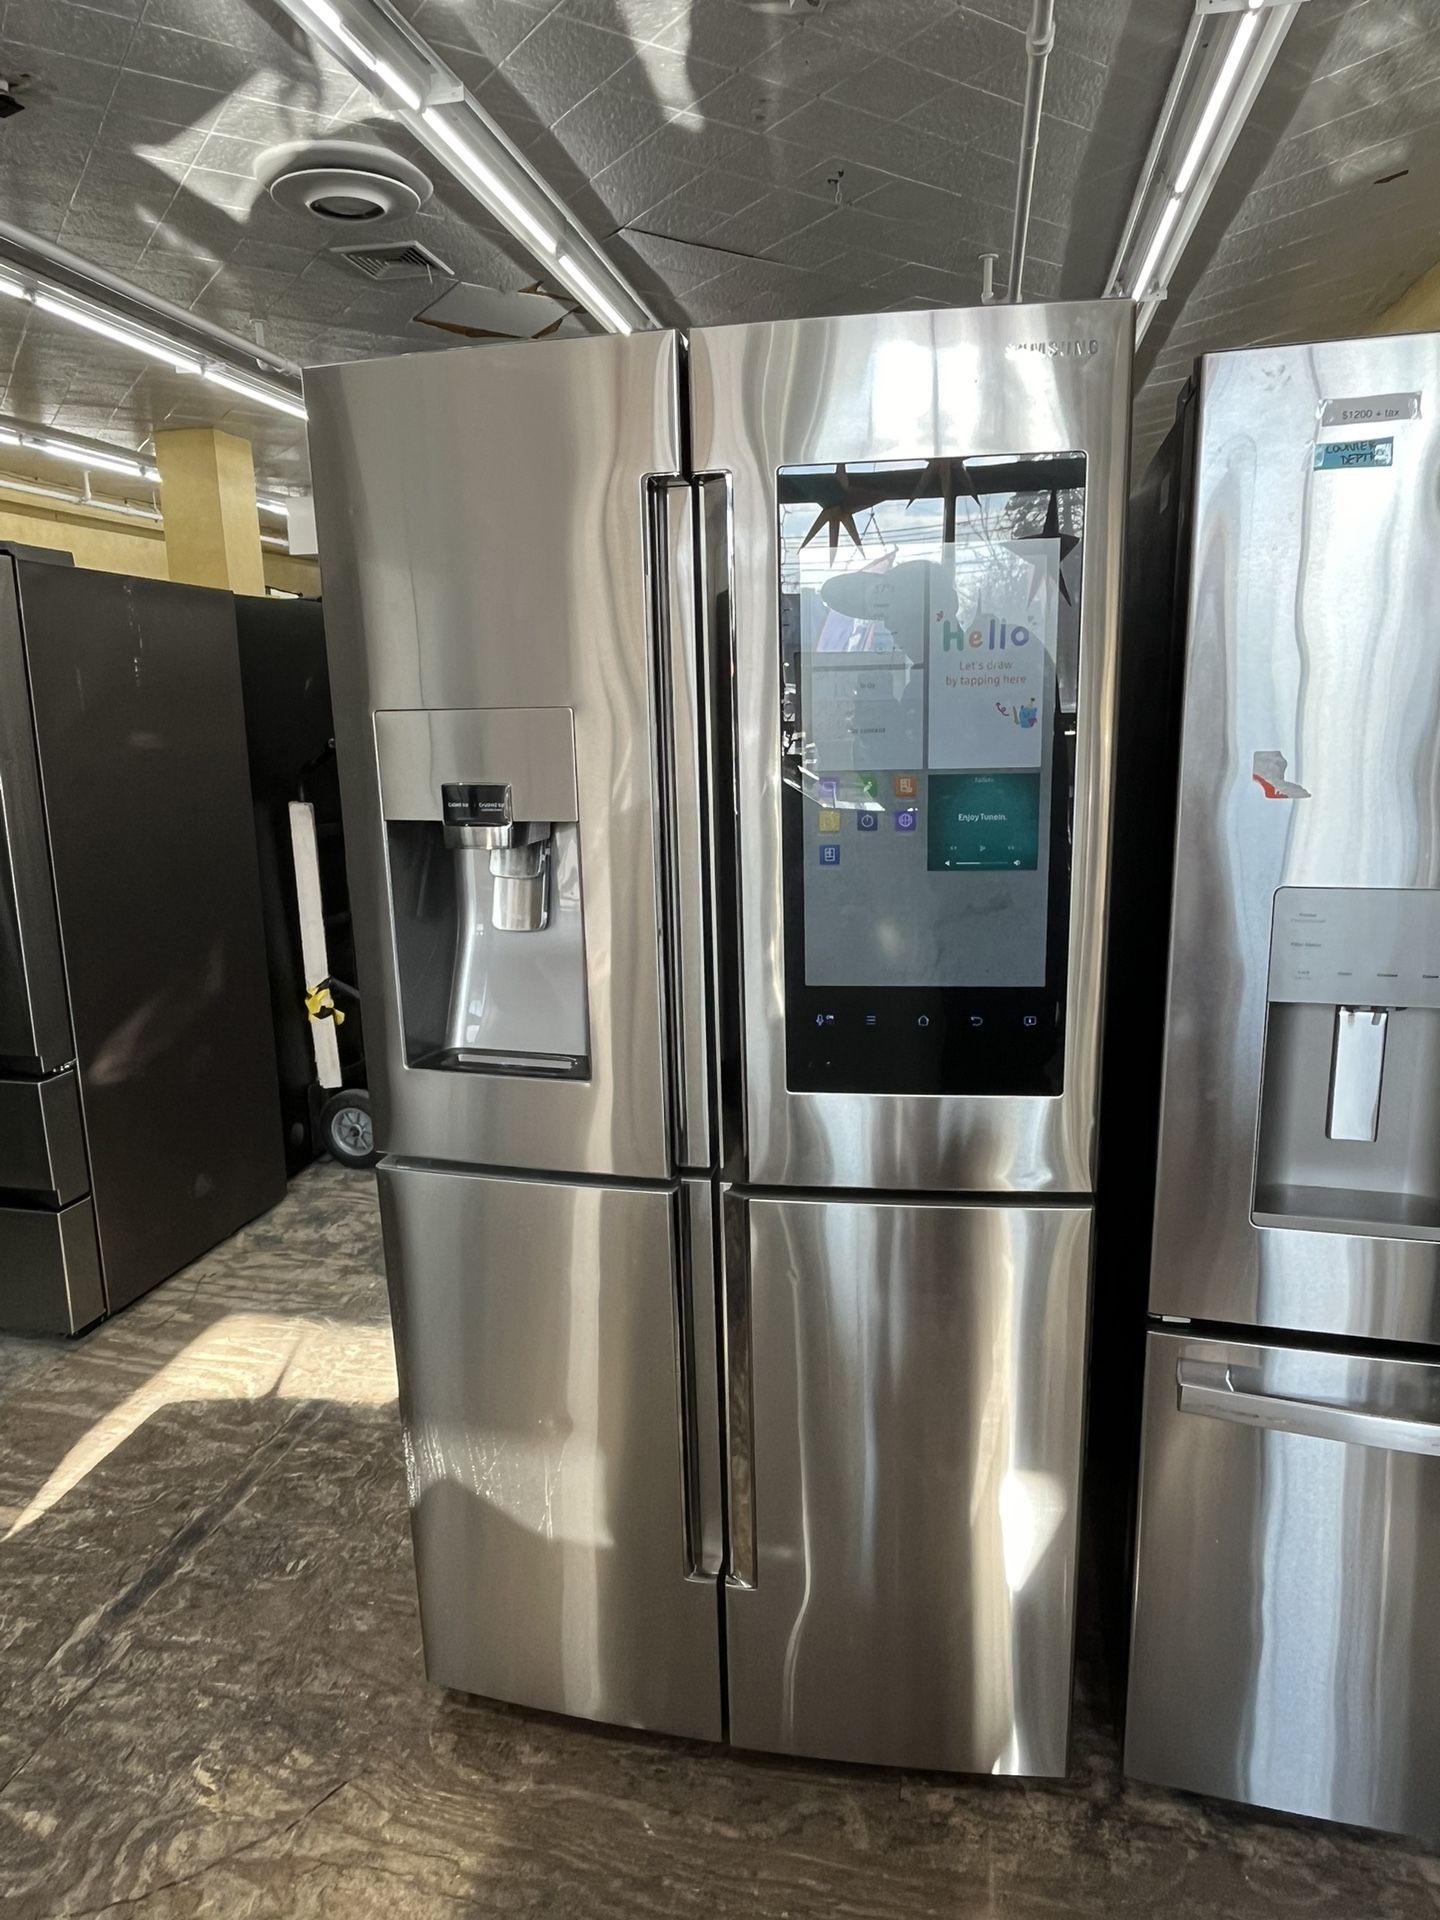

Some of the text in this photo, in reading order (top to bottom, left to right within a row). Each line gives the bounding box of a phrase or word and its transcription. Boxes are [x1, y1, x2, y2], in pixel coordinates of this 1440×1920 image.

[1342, 409, 1373, 420] $1200
[1385, 408, 1400, 418] tax
[943, 619, 1030, 652] Hello
[960, 660, 1014, 671] Let's draw
[946, 674, 1027, 688] by tapping here
[958, 813, 980, 823] Enjoy
